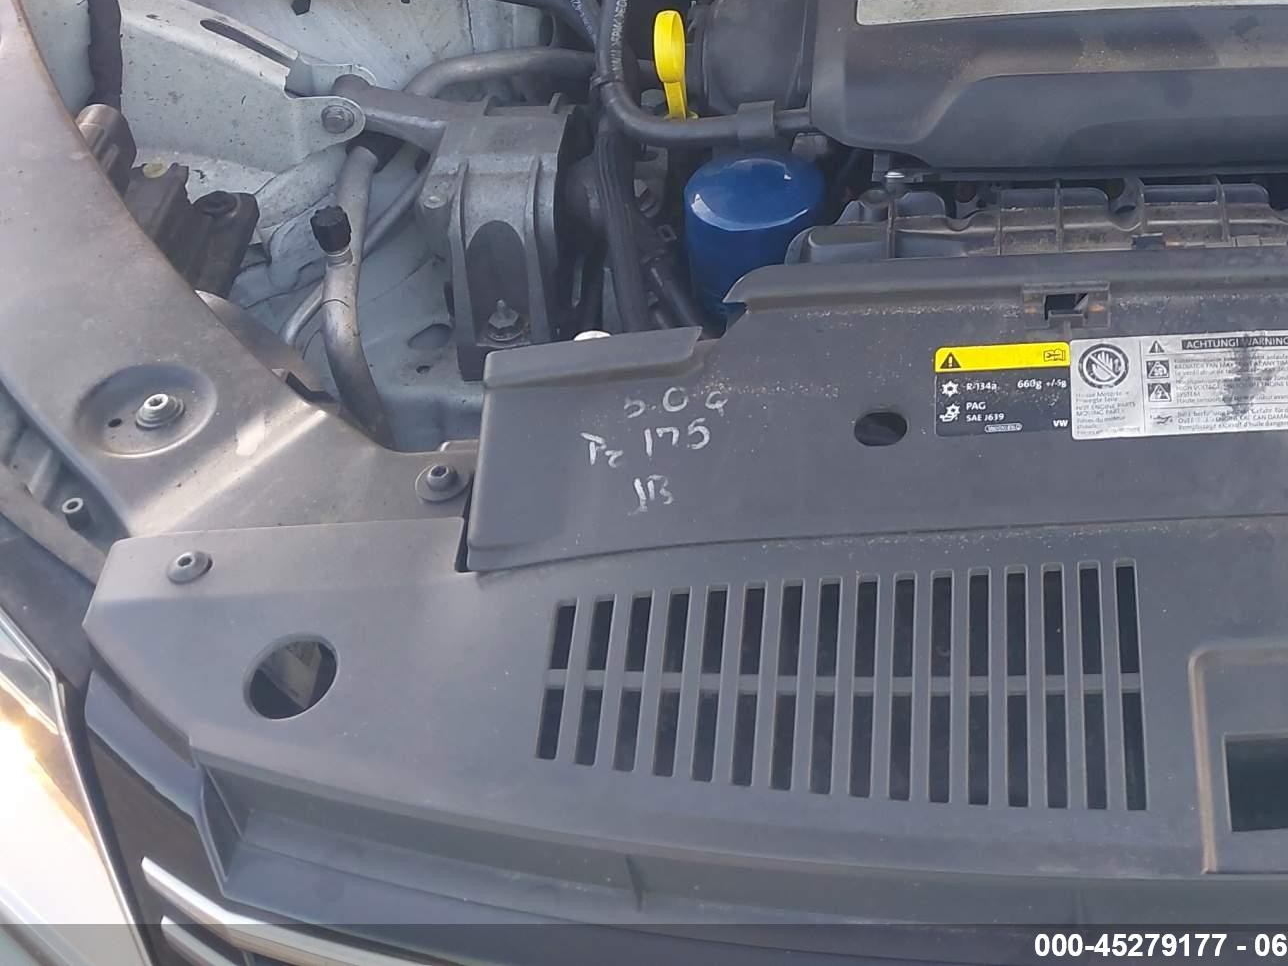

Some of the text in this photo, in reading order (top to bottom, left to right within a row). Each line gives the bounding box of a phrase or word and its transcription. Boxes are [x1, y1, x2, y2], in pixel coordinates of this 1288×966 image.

[1186, 338, 1239, 349] ACHTUNG!
[1017, 379, 1042, 390] 660g
[966, 401, 986, 410] PAG
[966, 413, 1004, 422] SAE J639
[1053, 419, 1068, 428] VW
[644, 417, 711, 457] 175
